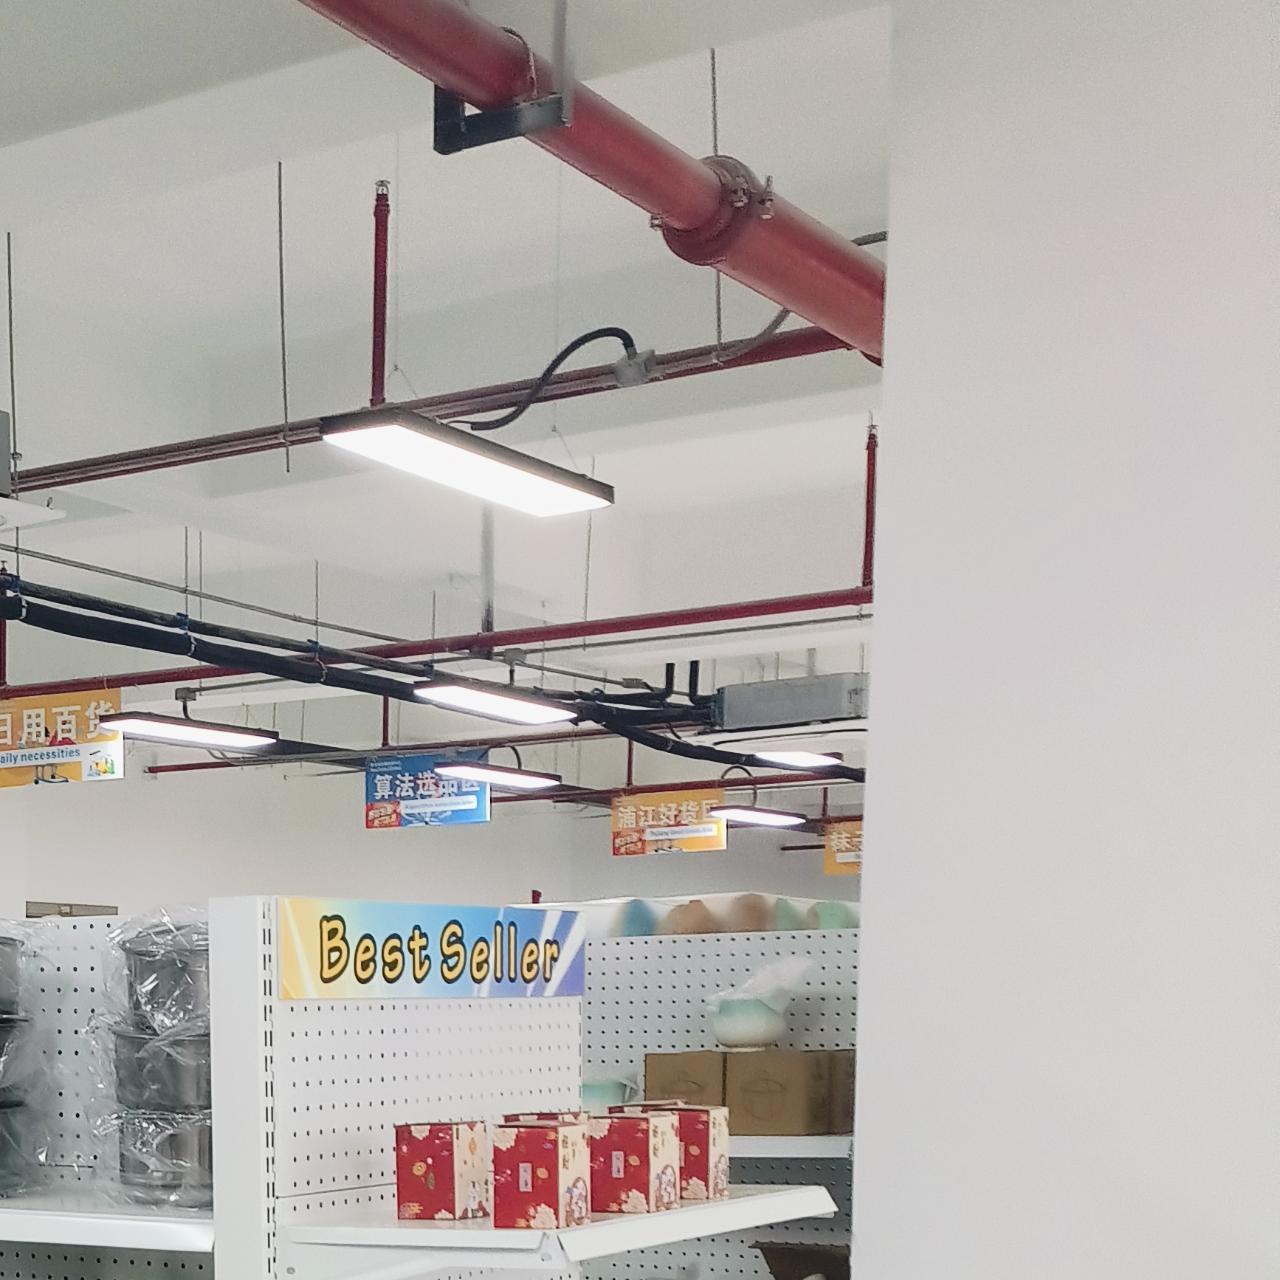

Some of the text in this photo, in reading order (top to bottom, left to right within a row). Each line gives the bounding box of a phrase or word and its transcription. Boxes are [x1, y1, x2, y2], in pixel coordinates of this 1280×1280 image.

[20, 748, 81, 763] necessities
[320, 914, 559, 984] Best Seller
